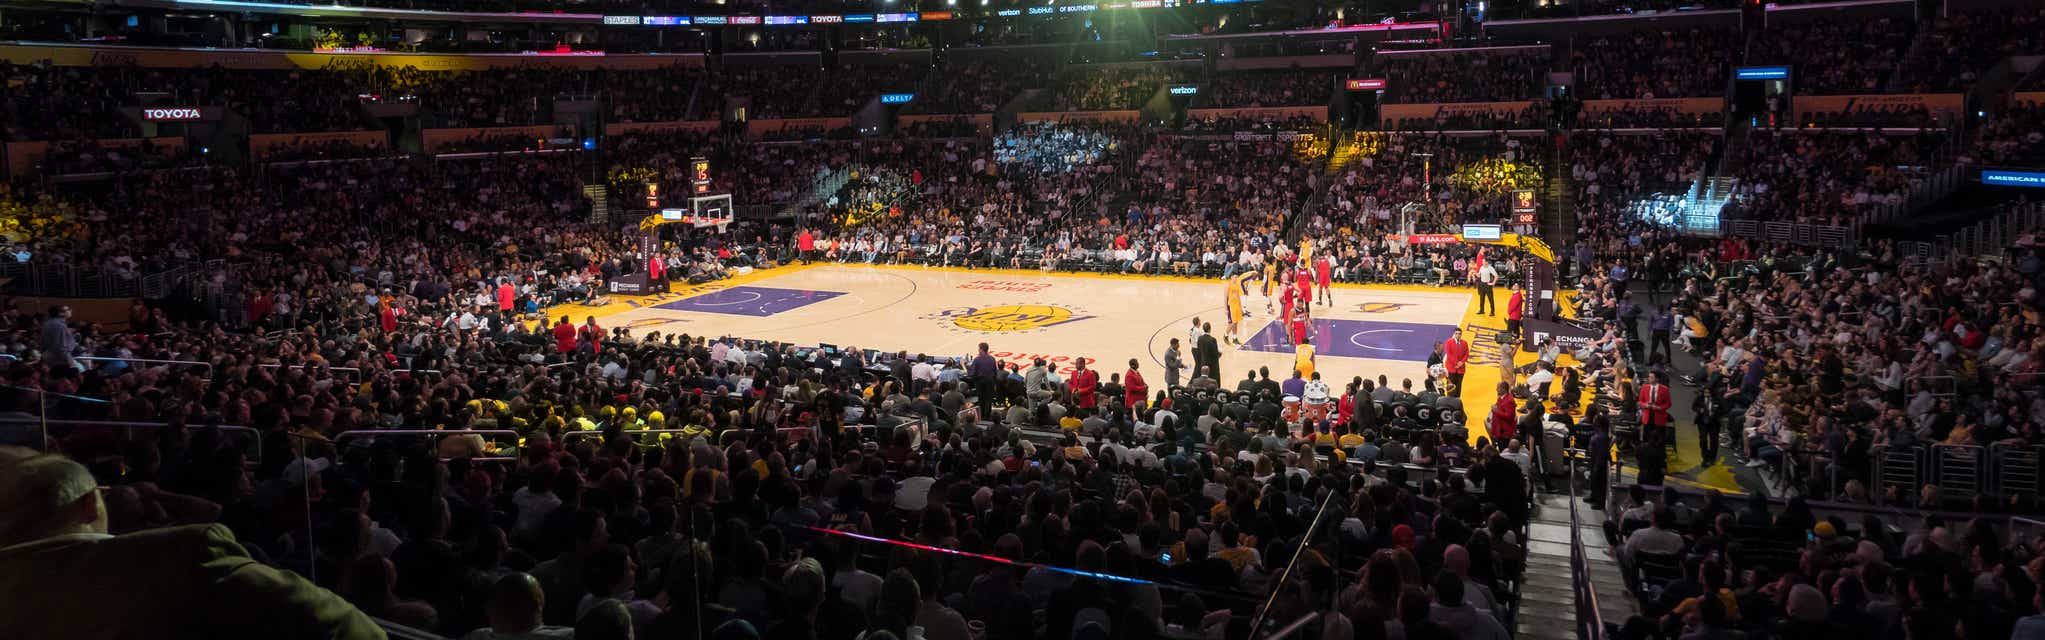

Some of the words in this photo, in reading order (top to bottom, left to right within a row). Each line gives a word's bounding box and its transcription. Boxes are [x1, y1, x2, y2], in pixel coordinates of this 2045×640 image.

[1028, 7, 1054, 15] StubHub
[1170, 86, 1197, 95] verizon
[889, 95, 913, 103] DELTA
[145, 109, 201, 119] TOYOTA
[1987, 175, 2039, 183] AMERICAN
[1217, 392, 1227, 403] G
[1440, 410, 1452, 421] G
